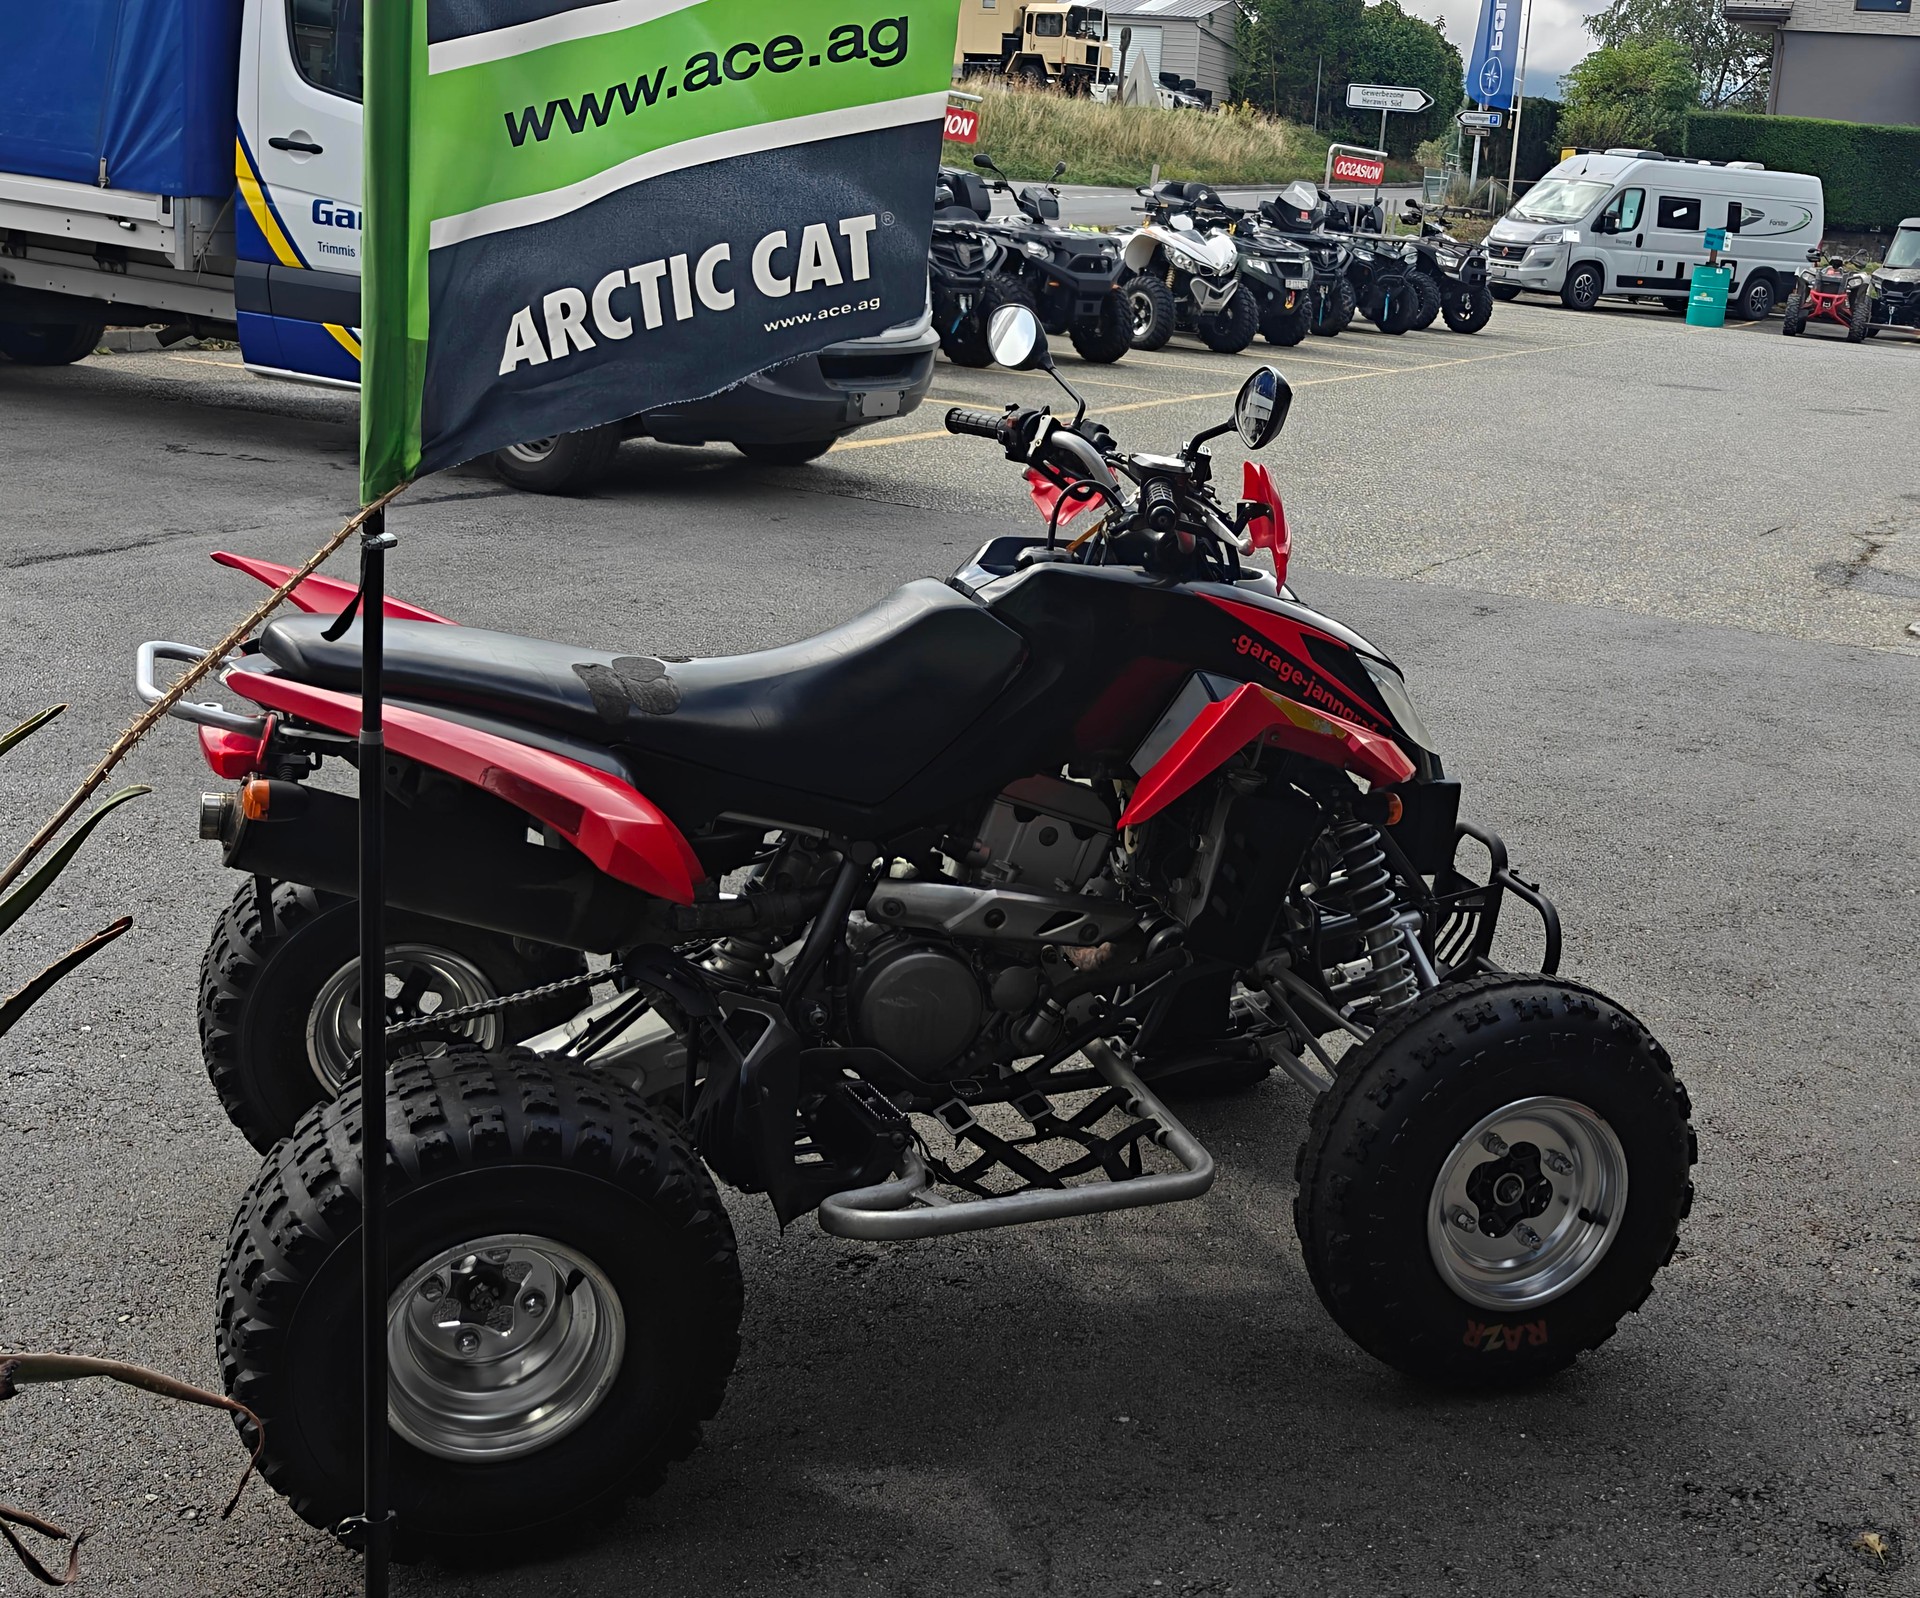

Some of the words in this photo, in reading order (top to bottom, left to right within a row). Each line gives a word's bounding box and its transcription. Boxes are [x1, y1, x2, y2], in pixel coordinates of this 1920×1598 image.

[504, 15, 909, 147] www.ace.ag
[1361, 88, 1405, 99] Gewerbezone
[944, 114, 975, 137] ION
[1336, 161, 1382, 180] OCCASION
[317, 241, 356, 257] Trimmis
[498, 242, 736, 376] ARCTIC
[752, 214, 877, 298] CAT
[763, 297, 880, 333] www.ace.ag
[1462, 1319, 1548, 1352] RAZR
